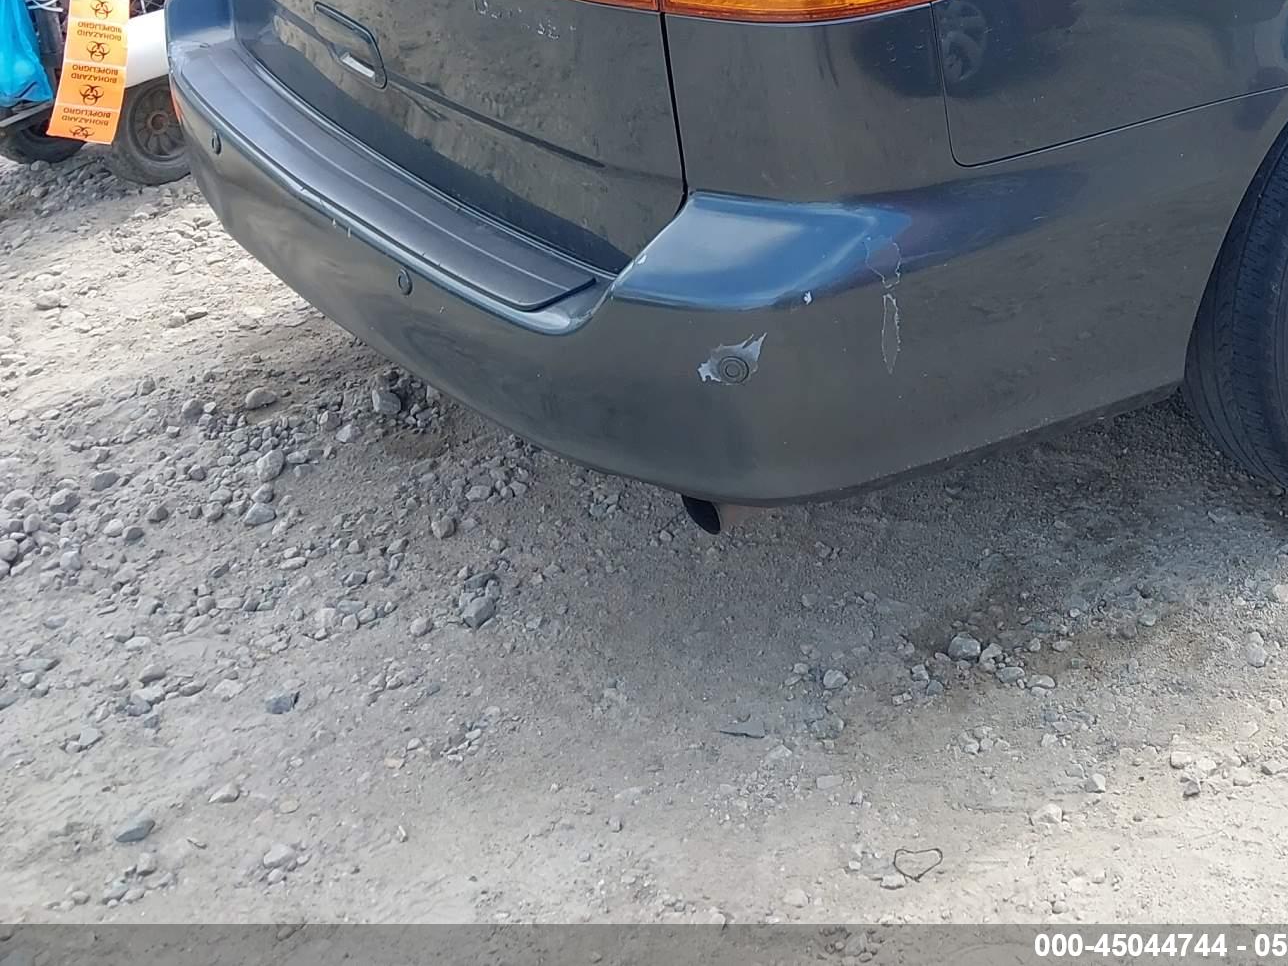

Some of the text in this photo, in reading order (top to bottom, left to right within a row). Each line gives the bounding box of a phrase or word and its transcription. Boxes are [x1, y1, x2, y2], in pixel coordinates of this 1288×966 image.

[77, 29, 122, 42] BIOHAZARD
[71, 64, 119, 76] BIOPELIGRO
[70, 72, 118, 84] BIOHAZARD
[63, 107, 112, 119] BIOPELIGRO
[61, 115, 109, 126] BIOHAZARD
